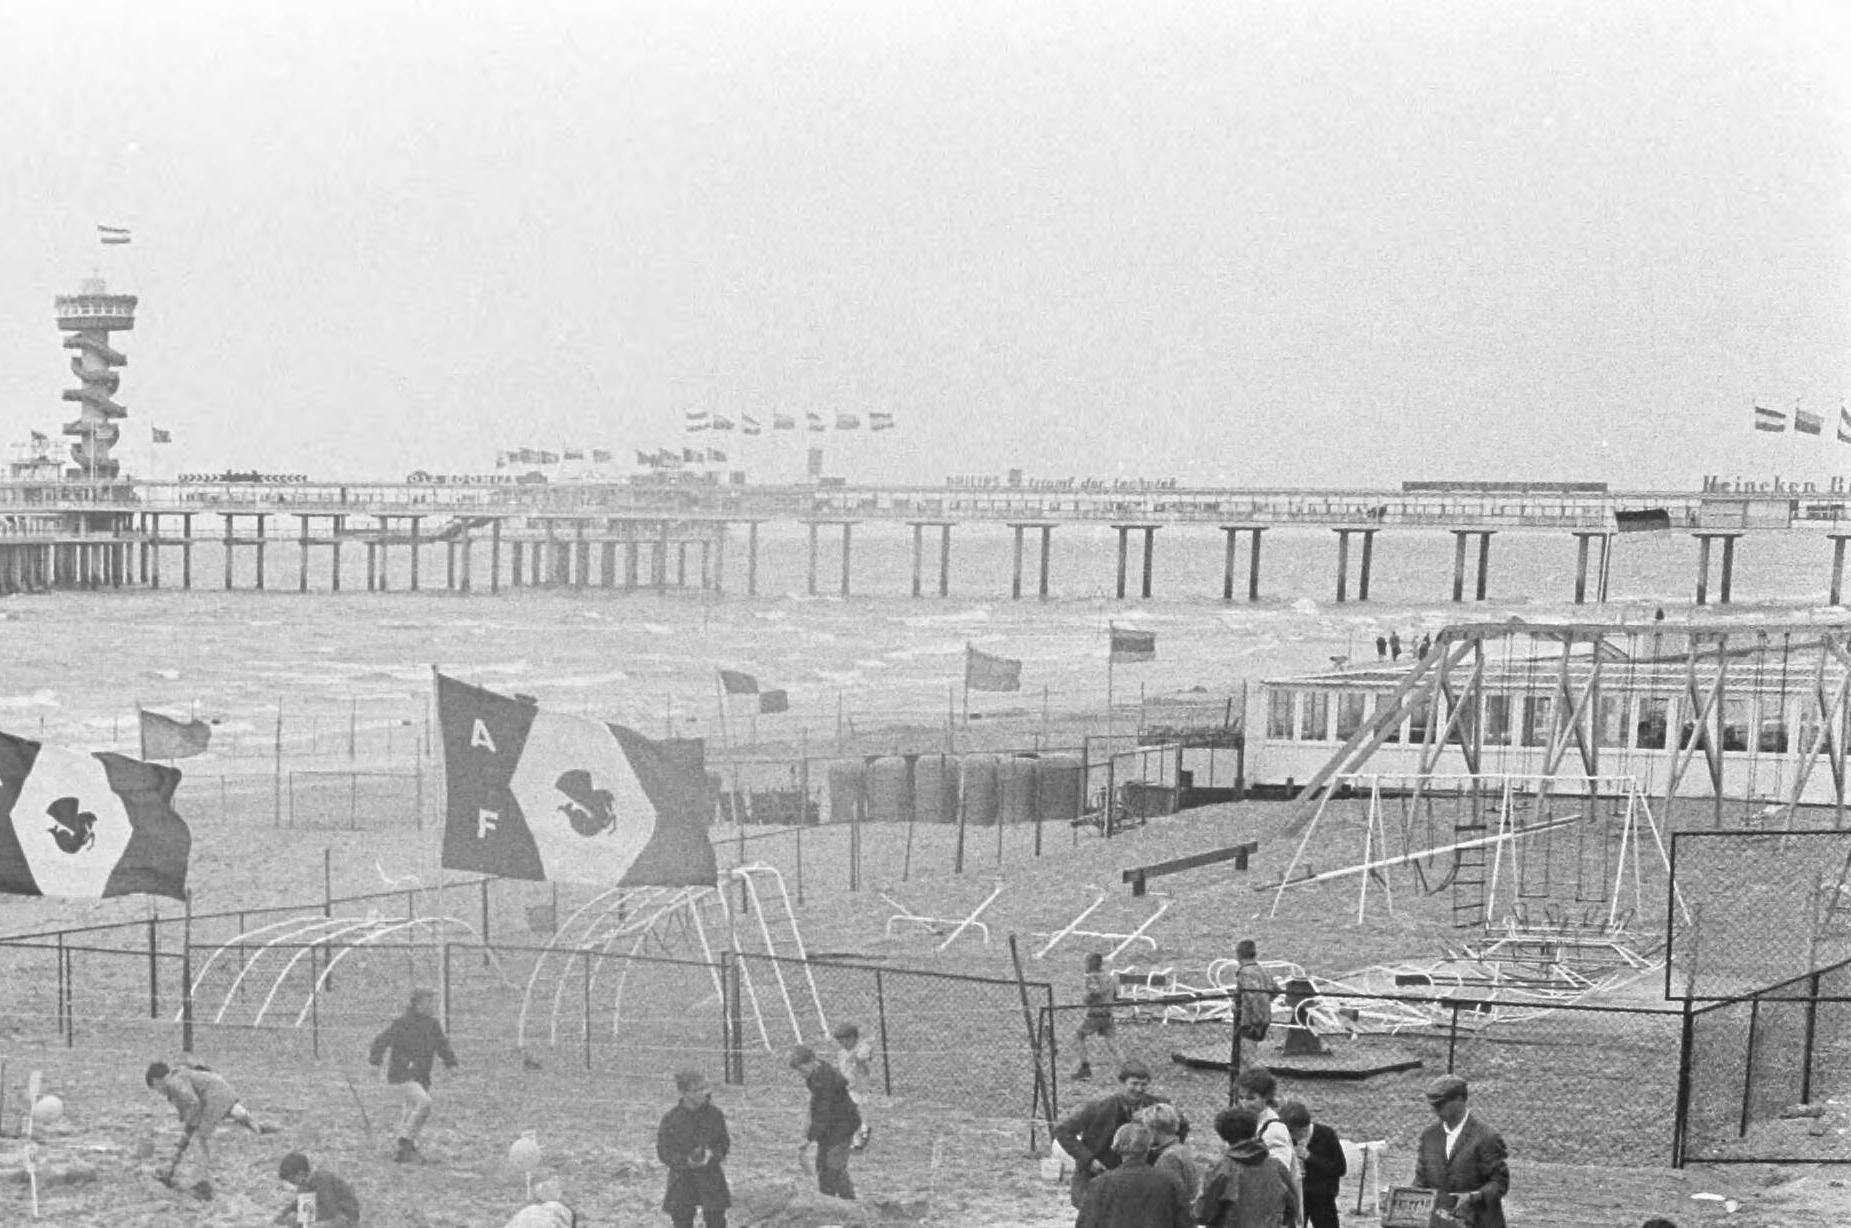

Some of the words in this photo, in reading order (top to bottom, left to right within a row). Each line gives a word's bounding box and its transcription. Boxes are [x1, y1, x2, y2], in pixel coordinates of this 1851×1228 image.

[1702, 475, 1817, 494] Heineken
[470, 718, 497, 753] A
[476, 808, 499, 839] F
